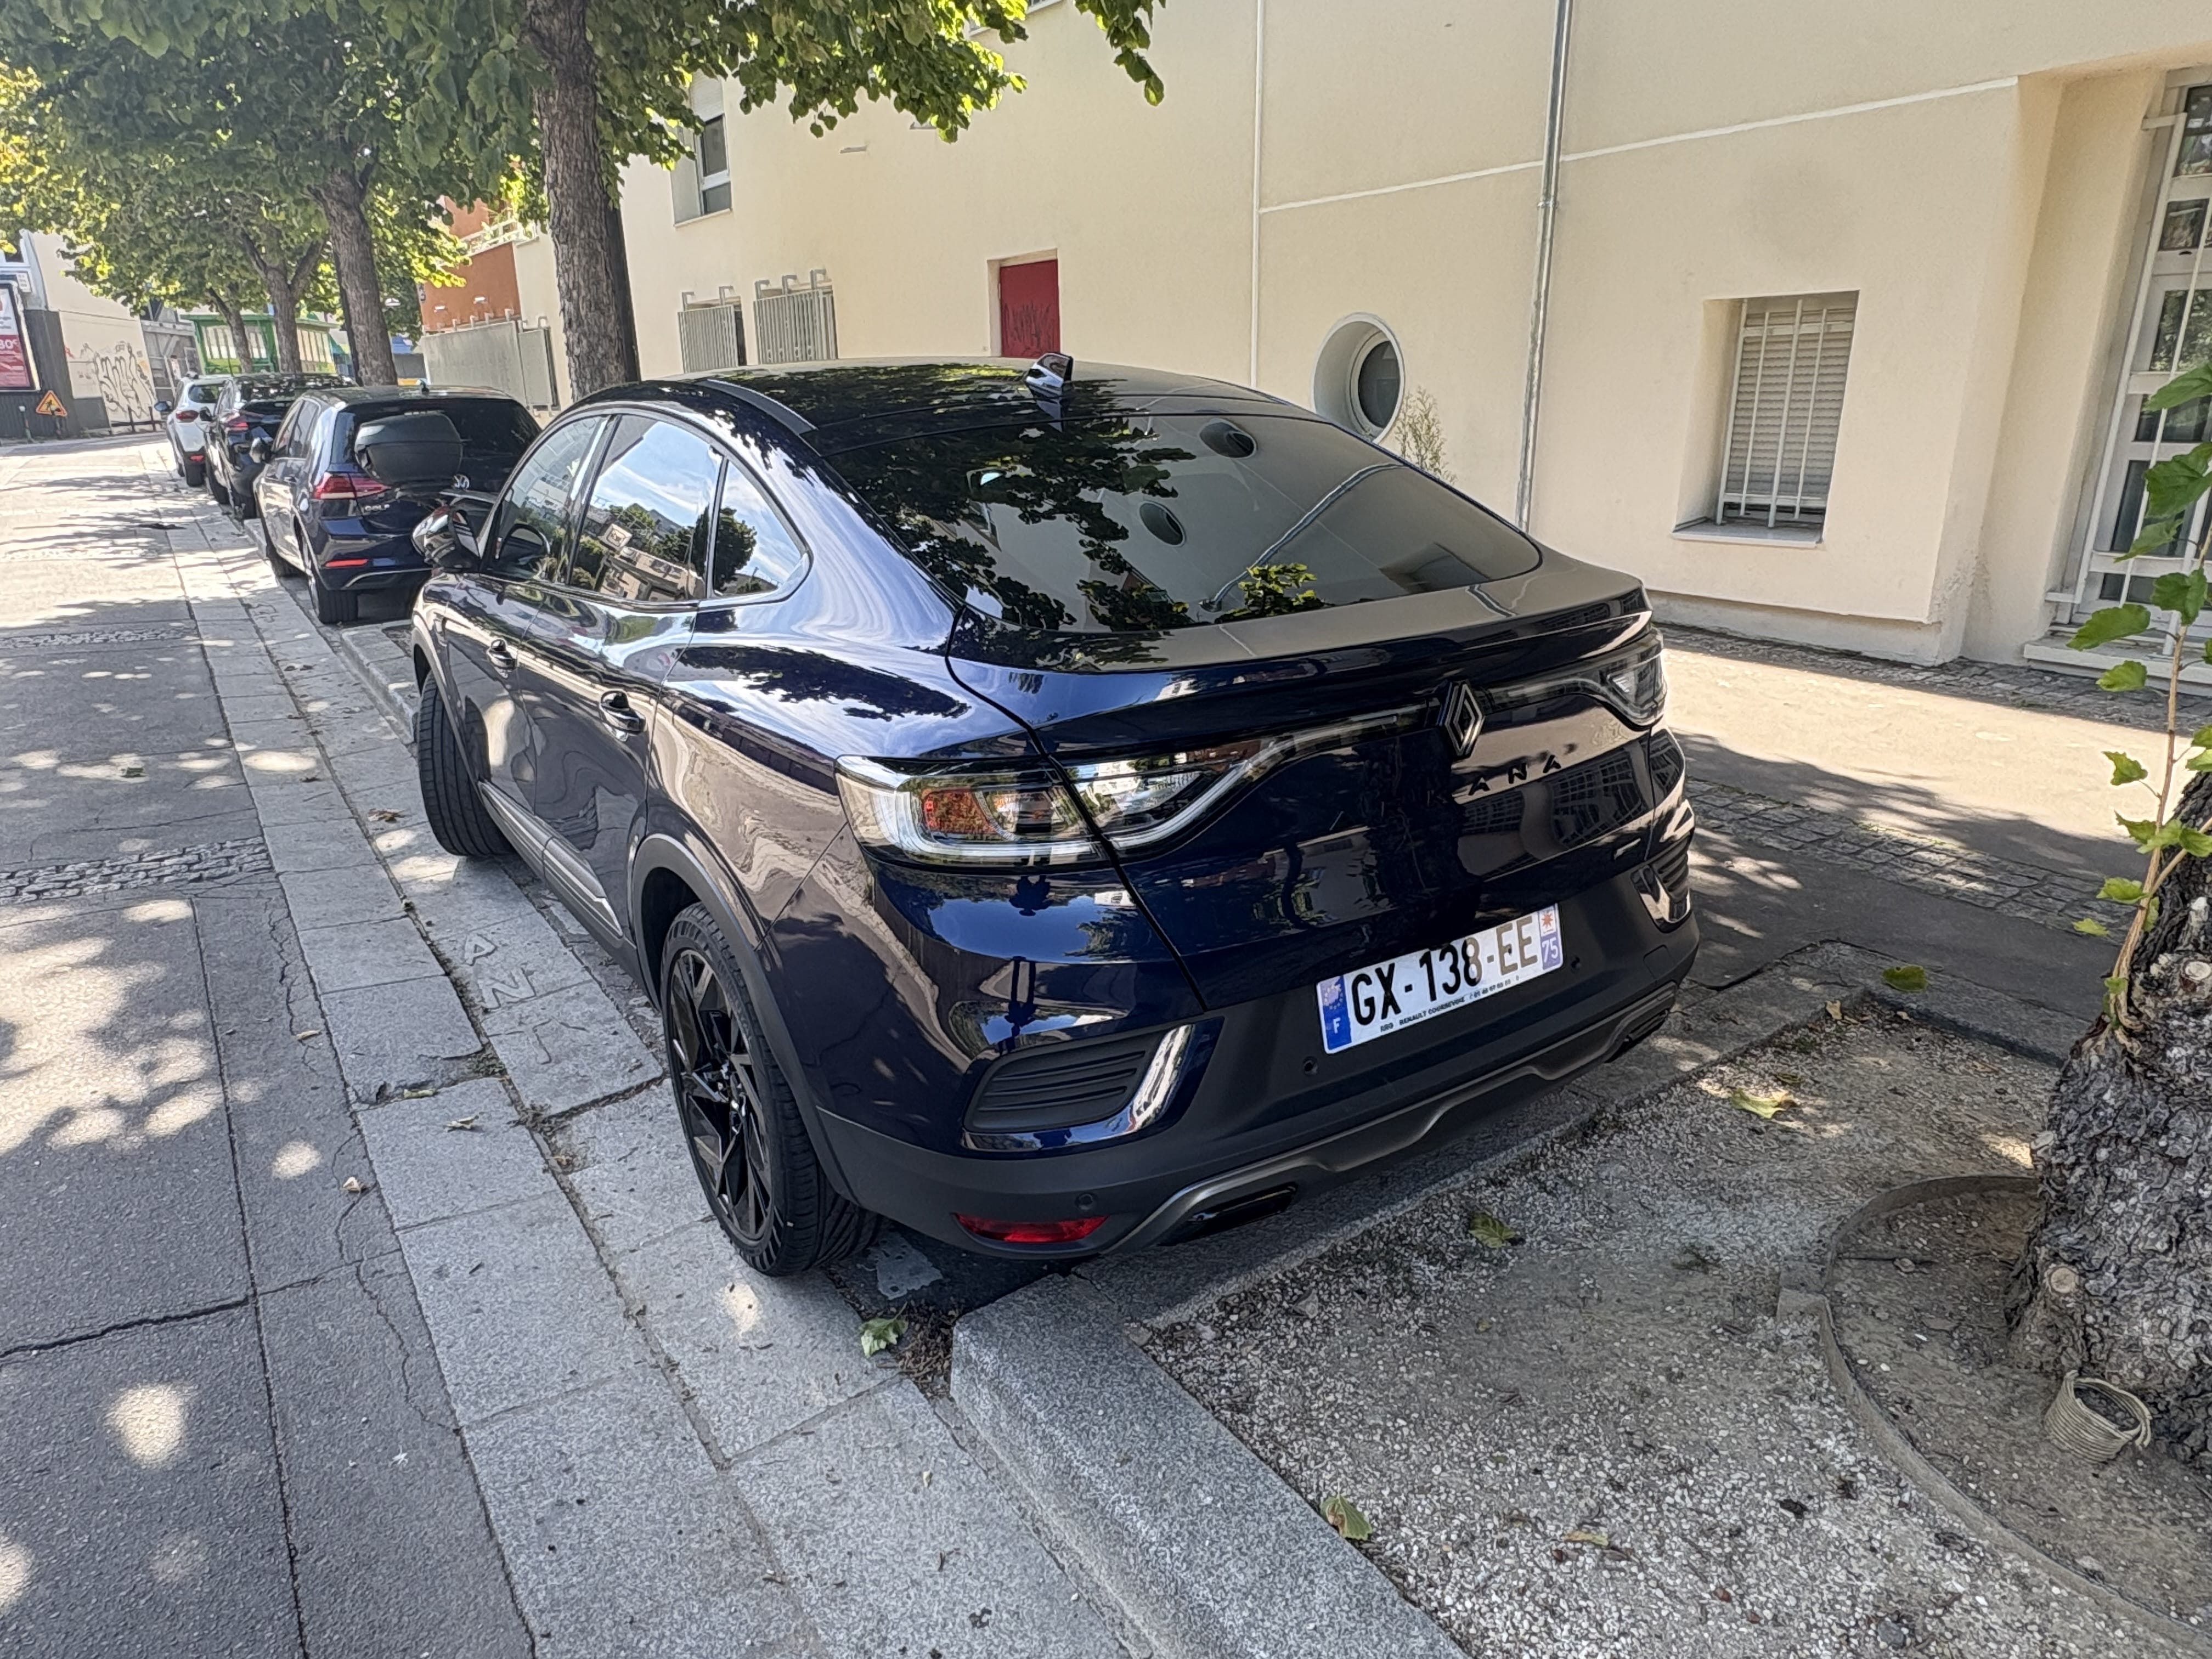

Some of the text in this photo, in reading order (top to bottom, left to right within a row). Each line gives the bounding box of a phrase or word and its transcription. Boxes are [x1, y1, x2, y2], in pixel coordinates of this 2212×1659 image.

[1542, 937, 1558, 963] 75
[1351, 915, 1539, 1026] GX-138-EE
[1333, 1017, 1342, 1034] F
